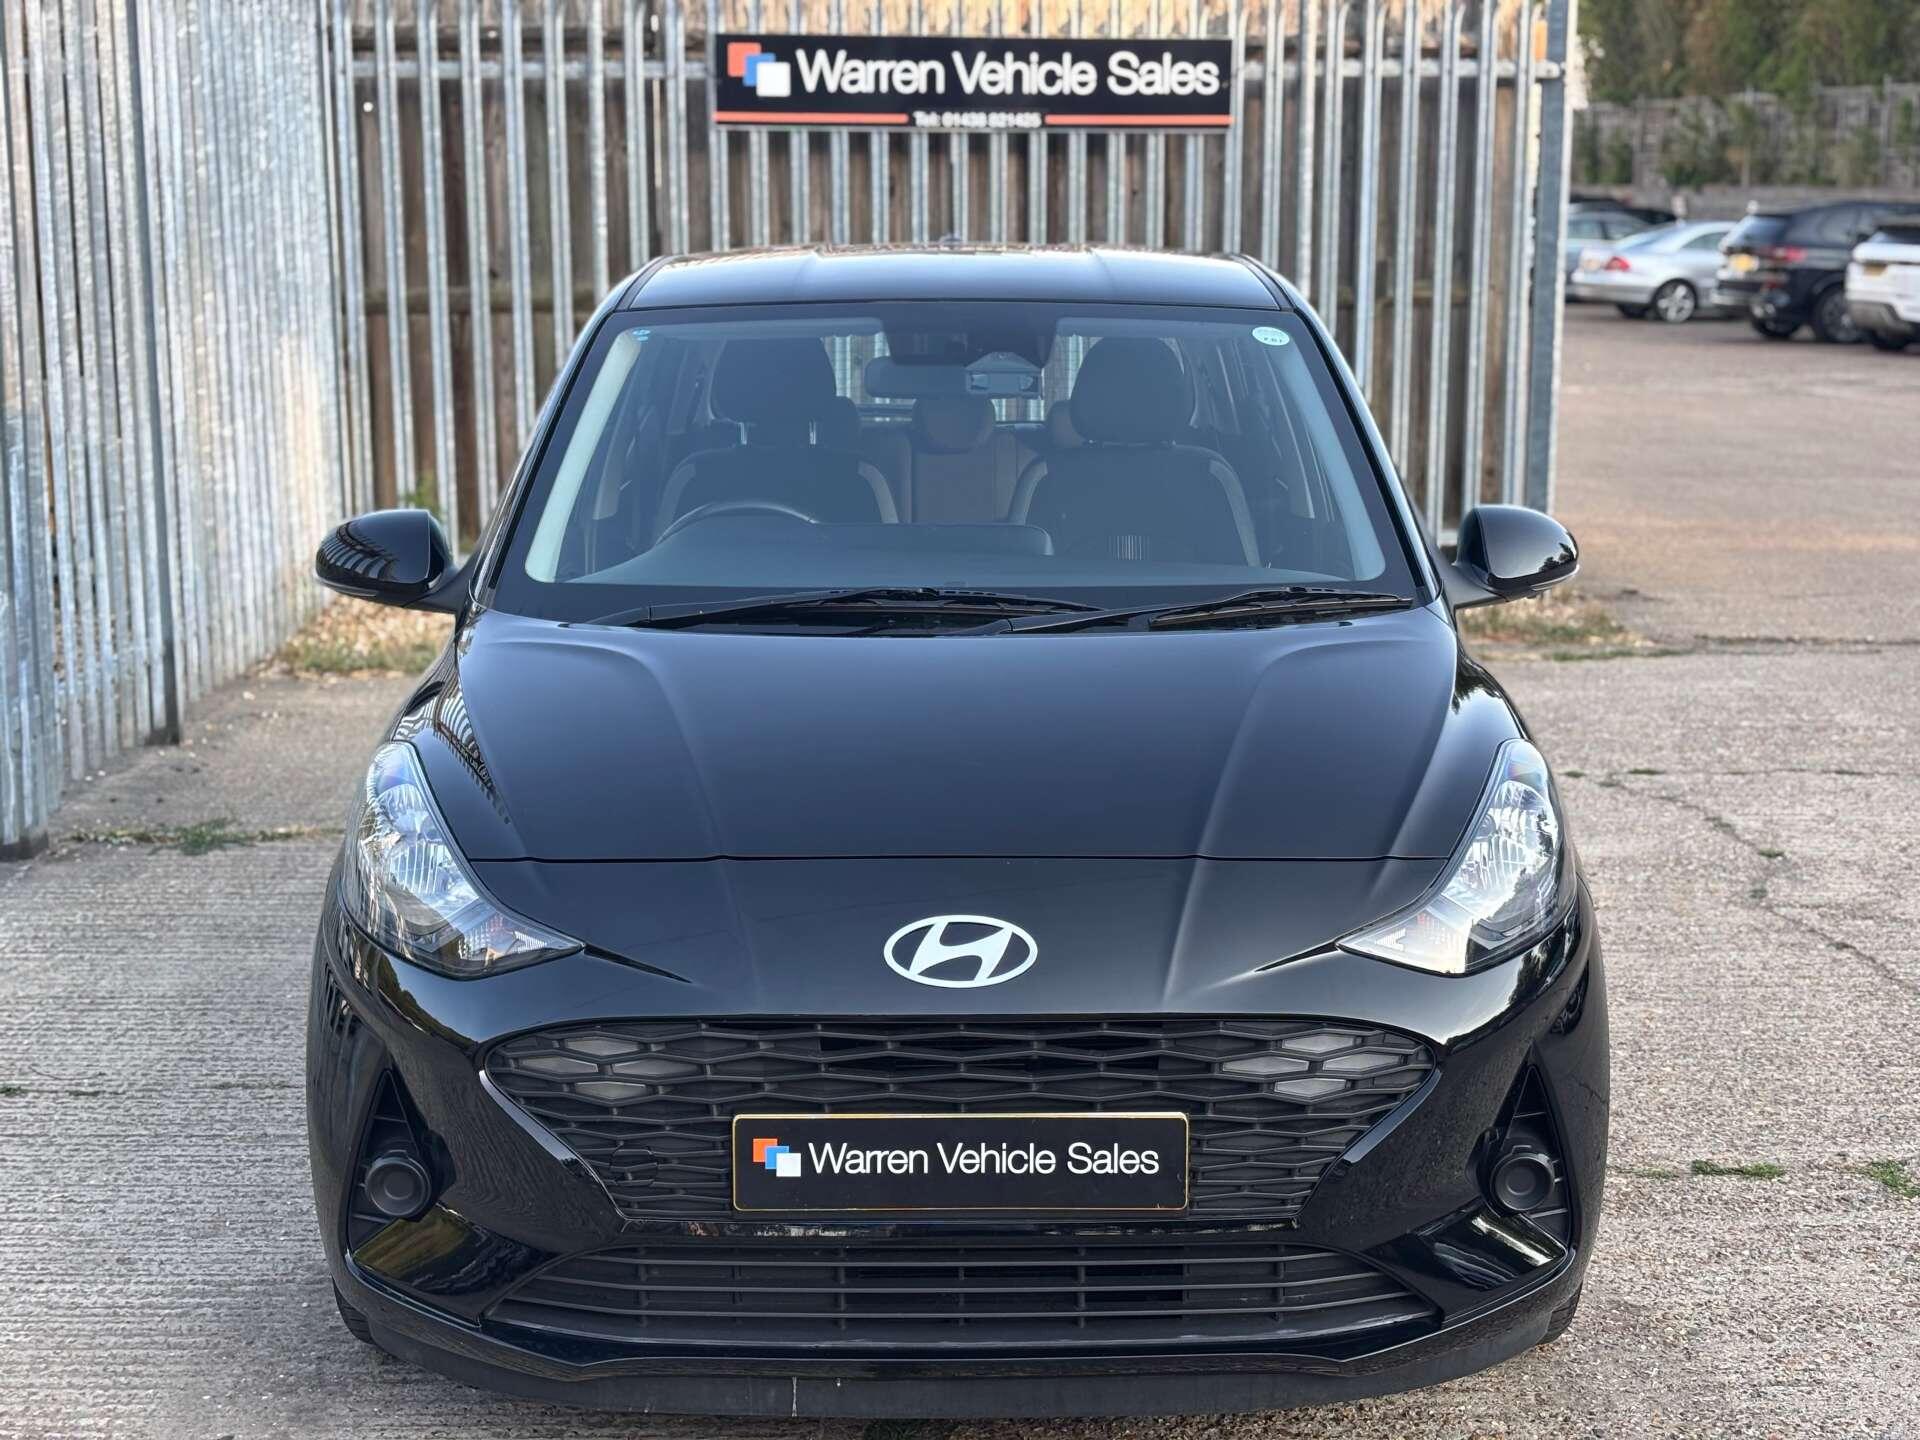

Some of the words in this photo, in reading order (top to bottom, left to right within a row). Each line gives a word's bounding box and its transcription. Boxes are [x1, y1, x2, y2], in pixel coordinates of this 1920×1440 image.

[795, 48, 946, 94] Warren
[951, 50, 1098, 95] Vehicle
[1106, 50, 1221, 96] Sales
[808, 1142, 929, 1175] Warren
[936, 1142, 1057, 1175] Vehicle
[1067, 1141, 1160, 1175] Sales
